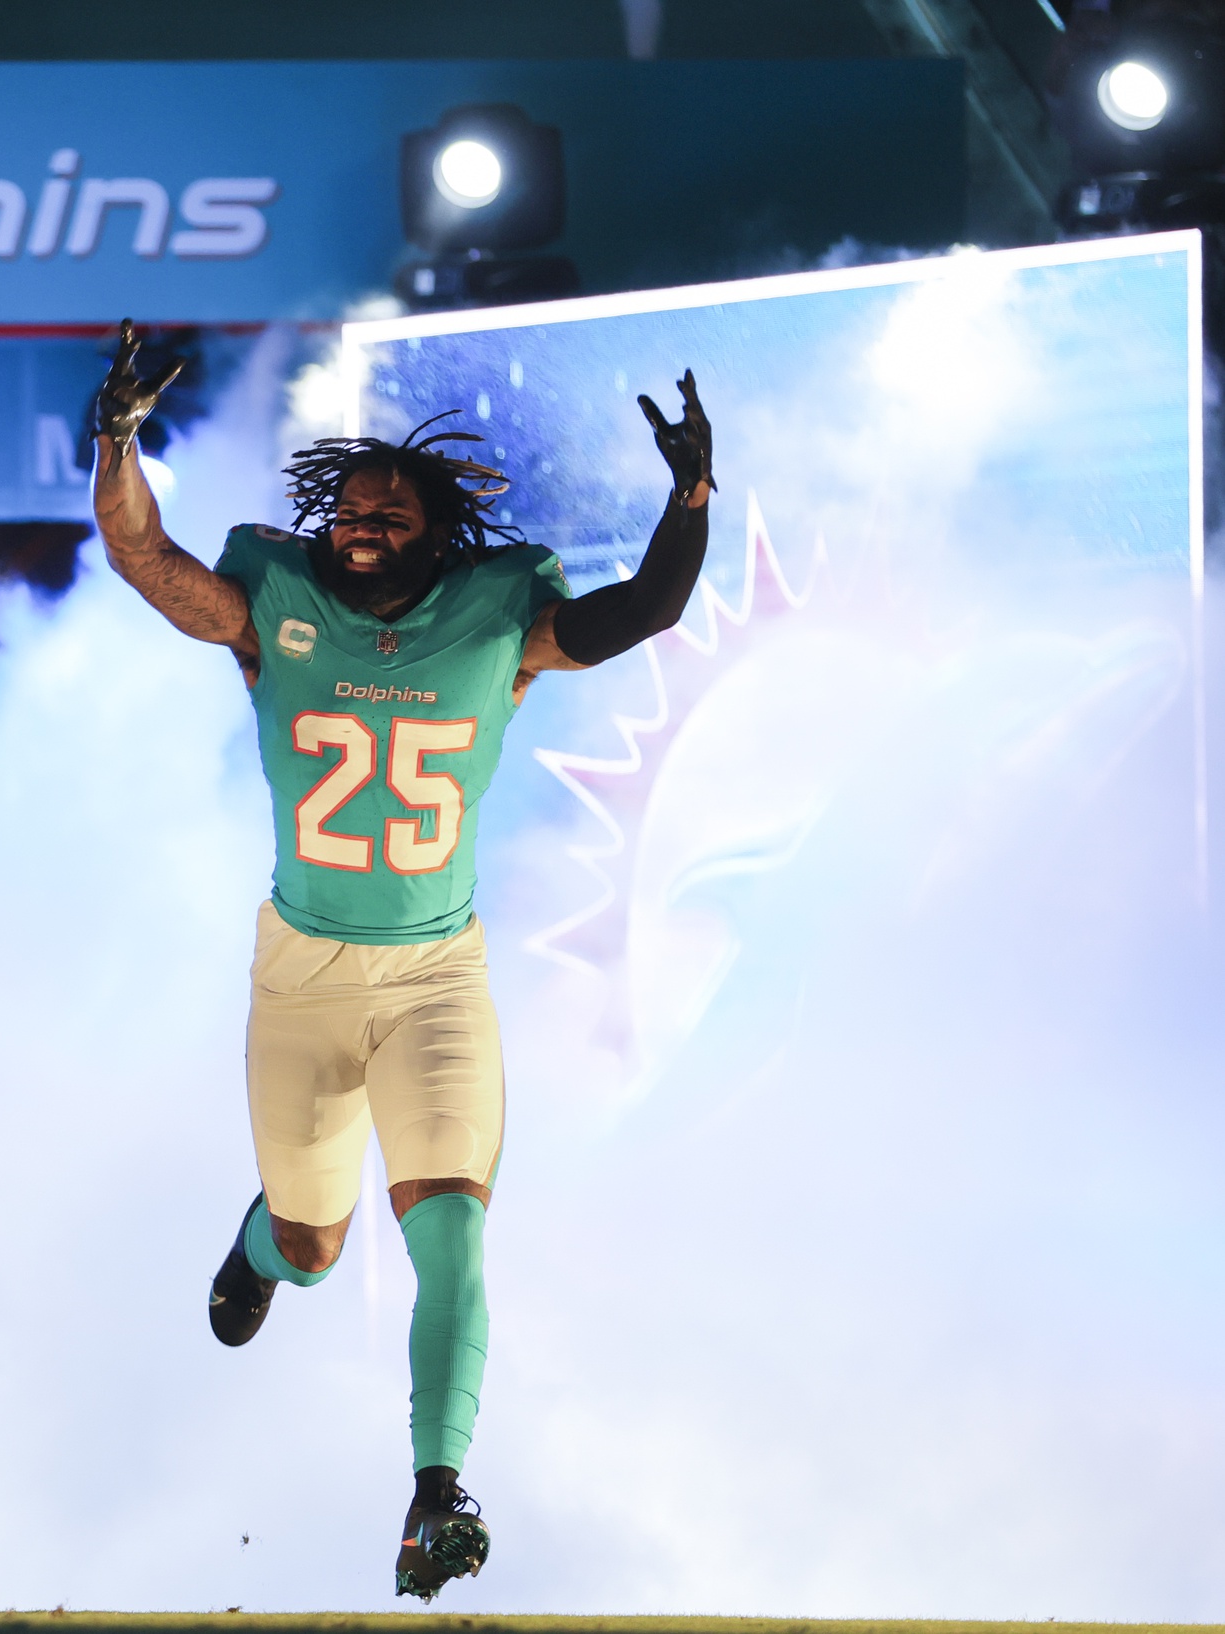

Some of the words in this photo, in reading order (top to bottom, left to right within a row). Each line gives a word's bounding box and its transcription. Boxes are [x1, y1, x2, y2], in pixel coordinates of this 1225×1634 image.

[279, 619, 317, 652] C
[335, 682, 437, 704] Dolphins
[291, 710, 476, 876] 25
